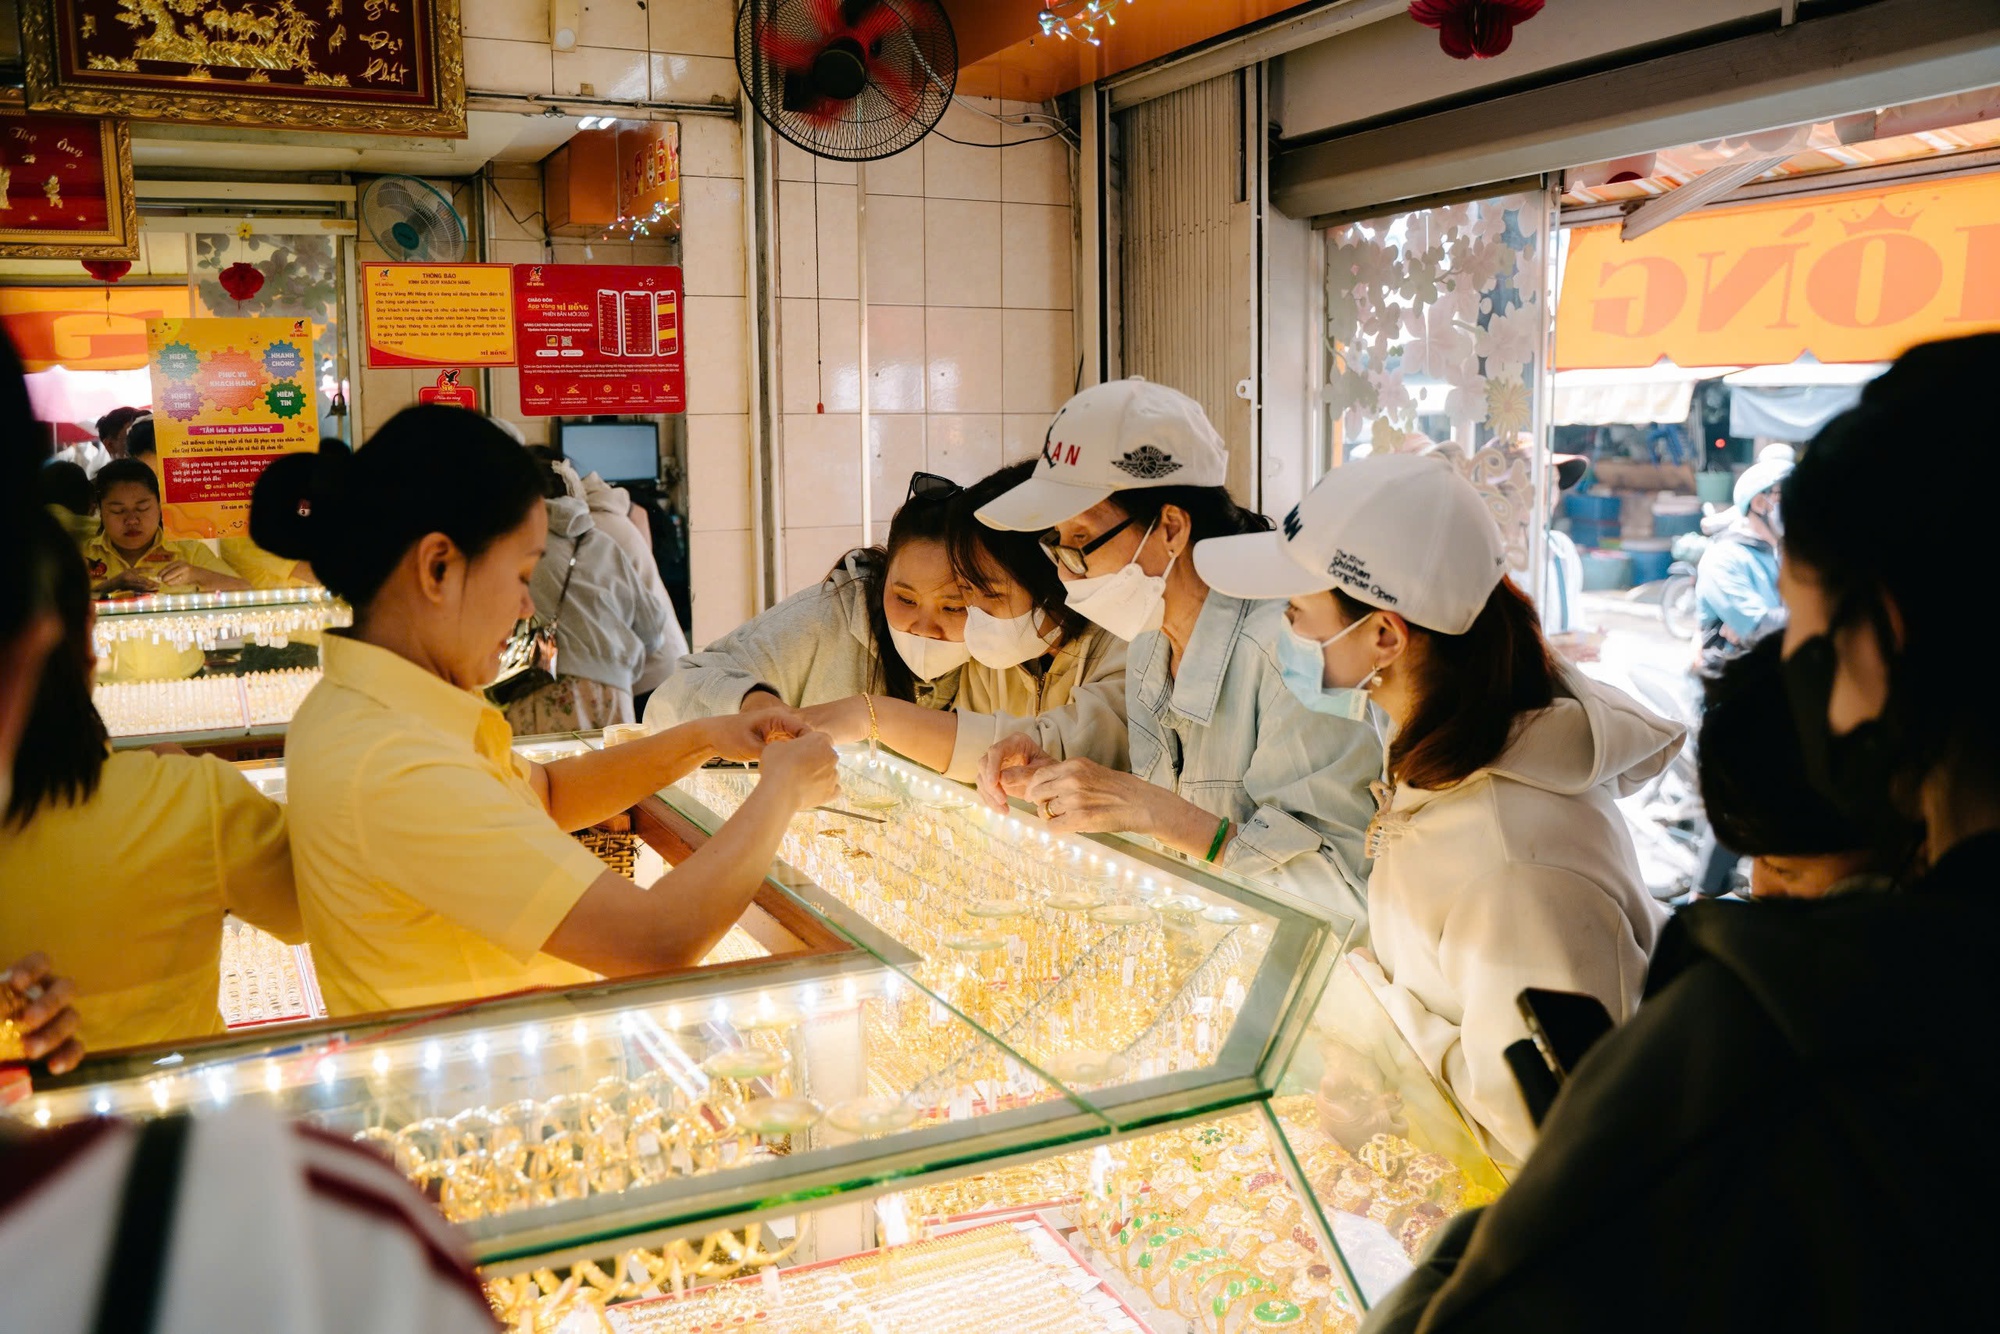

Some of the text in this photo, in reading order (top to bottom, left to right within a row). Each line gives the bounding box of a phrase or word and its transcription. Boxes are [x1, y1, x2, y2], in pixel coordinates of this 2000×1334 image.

[280, 399, 292, 407] TIN
[1332, 556, 1371, 580] Shinhan
[1327, 565, 1398, 606] Donghae Open
